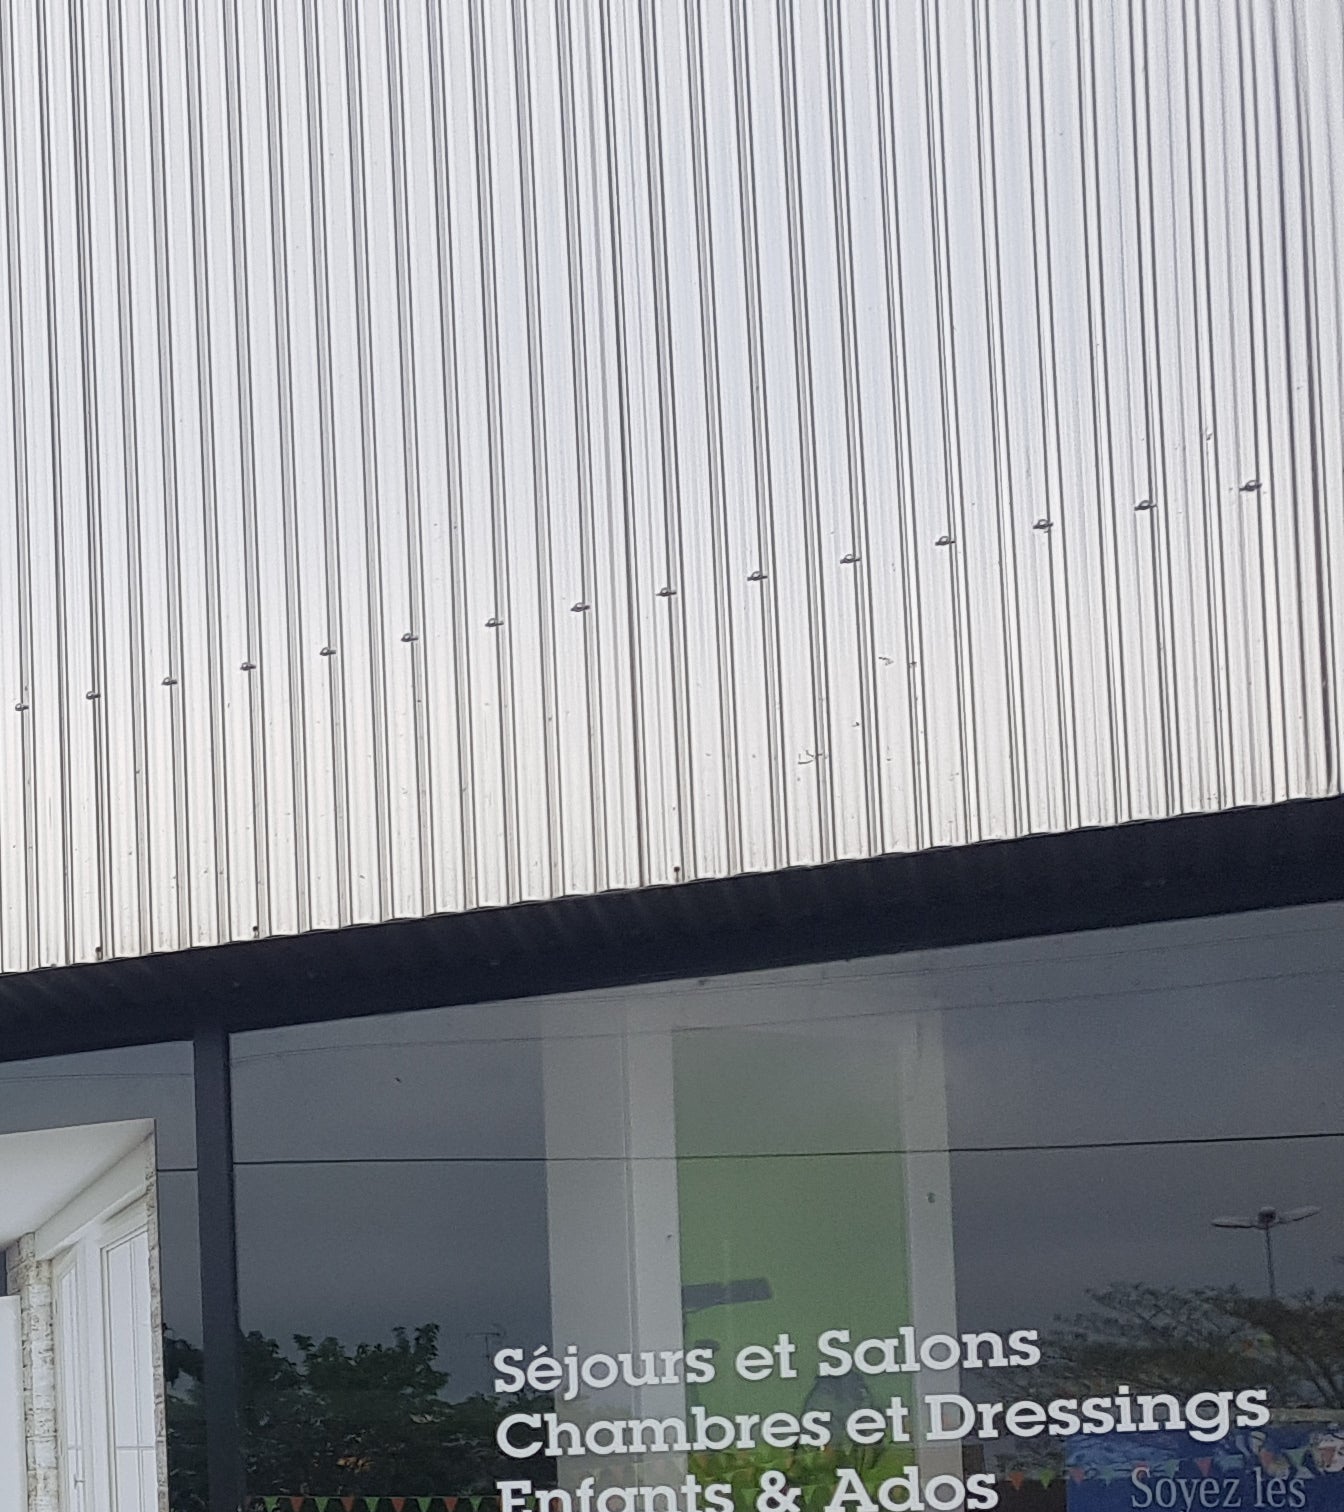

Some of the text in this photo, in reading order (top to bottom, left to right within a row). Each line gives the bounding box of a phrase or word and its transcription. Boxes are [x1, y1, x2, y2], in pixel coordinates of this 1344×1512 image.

[493, 1324, 1043, 1402] Séjours et Salons
[495, 1383, 1271, 1460] Chambres et Dressings
[1254, 1465, 1307, 1508] les
